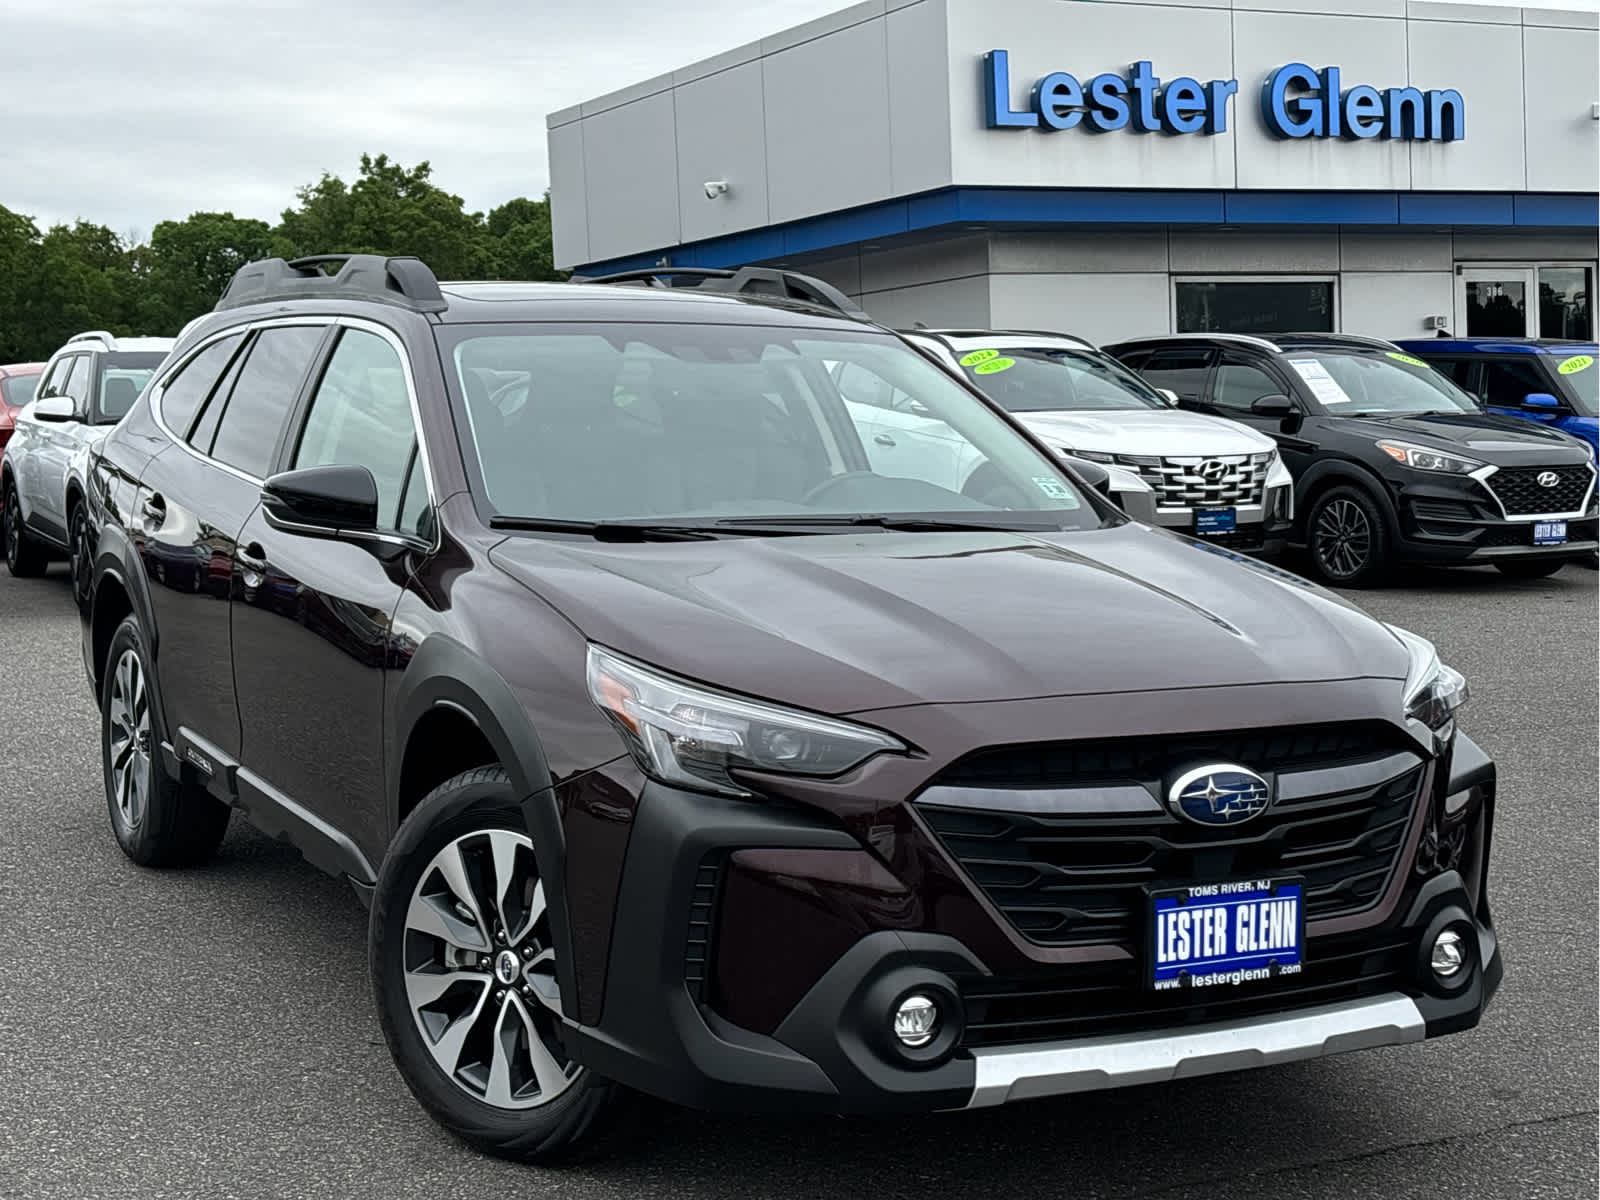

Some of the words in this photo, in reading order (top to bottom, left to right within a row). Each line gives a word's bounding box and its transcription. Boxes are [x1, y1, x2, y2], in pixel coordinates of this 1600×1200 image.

[984, 49, 1238, 134] Lester
[1262, 62, 1465, 141] Glenn
[1188, 887, 1218, 898] TOMS
[1257, 880, 1271, 890] NJ
[1157, 907, 1227, 963] LESTER
[1235, 900, 1297, 953] GLENN
